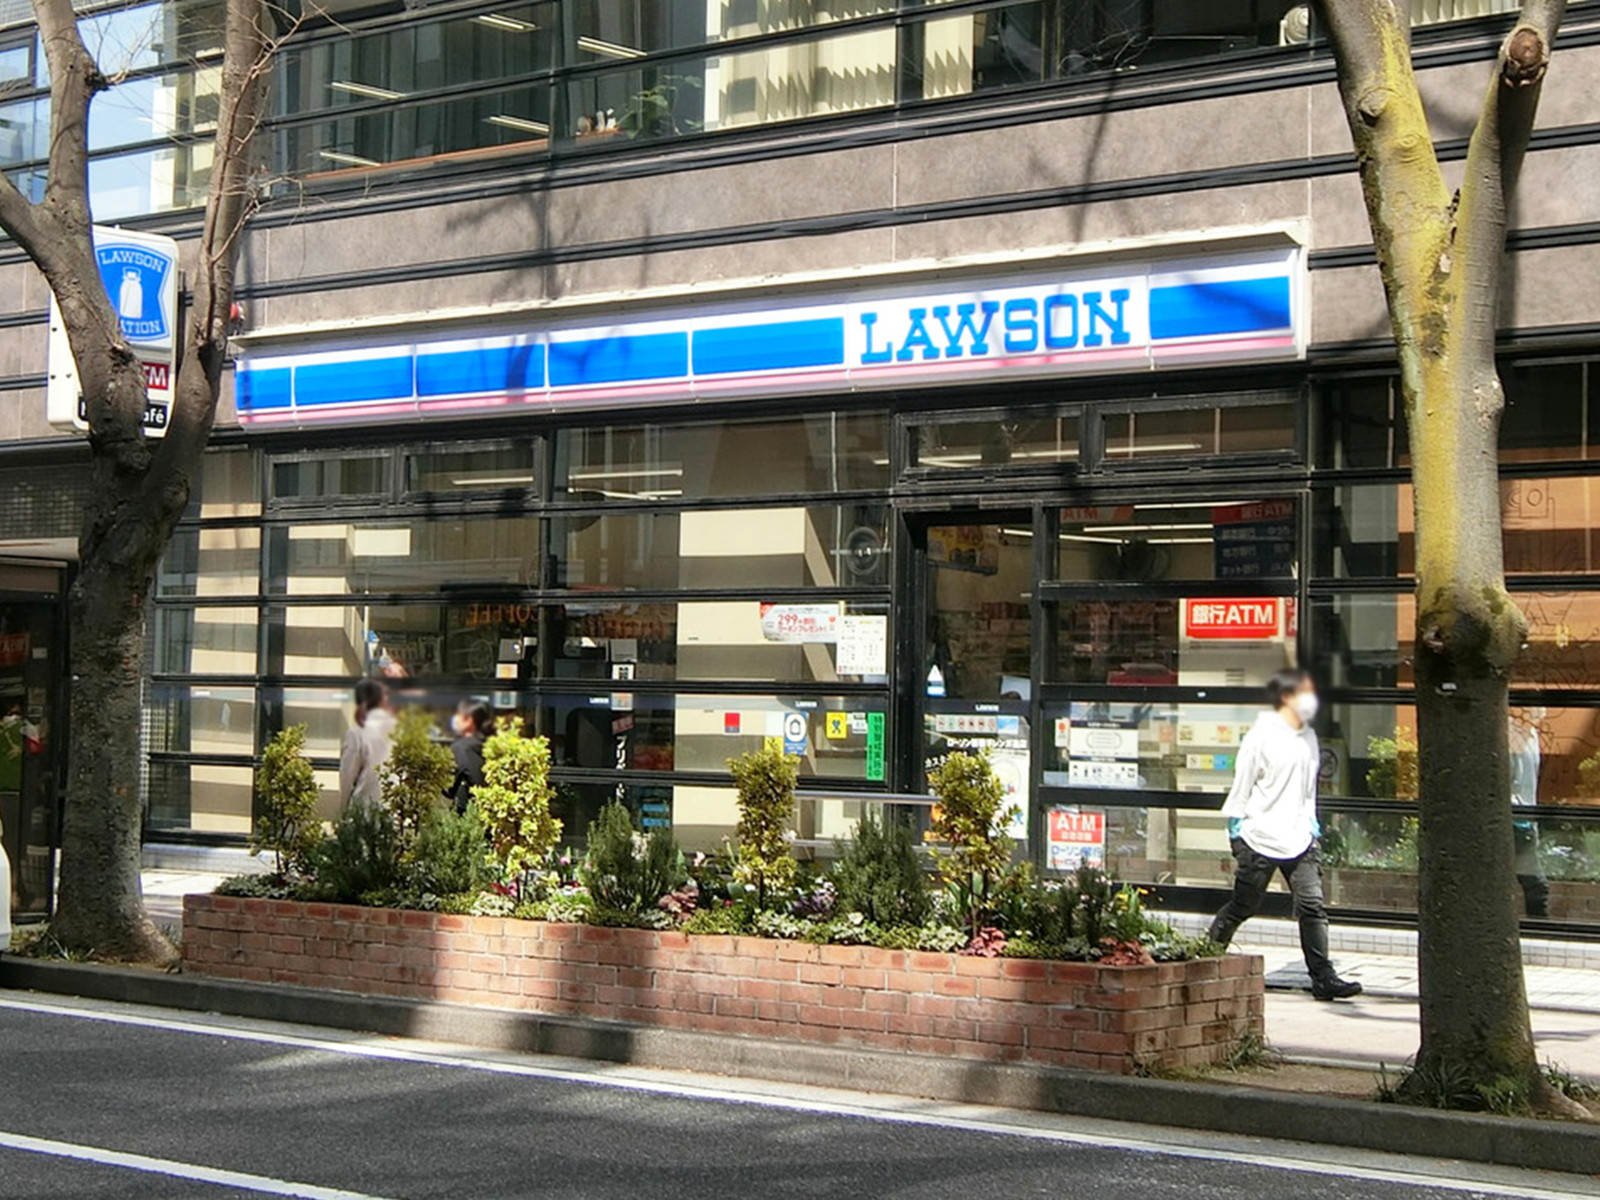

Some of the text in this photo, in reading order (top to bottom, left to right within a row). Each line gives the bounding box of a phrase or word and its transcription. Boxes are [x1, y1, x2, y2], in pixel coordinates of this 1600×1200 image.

[100, 251, 165, 273] LAWSON
[860, 288, 1131, 364] LAWSON
[1192, 604, 1273, 625] 銀行ATM
[1056, 813, 1096, 832] ATM
